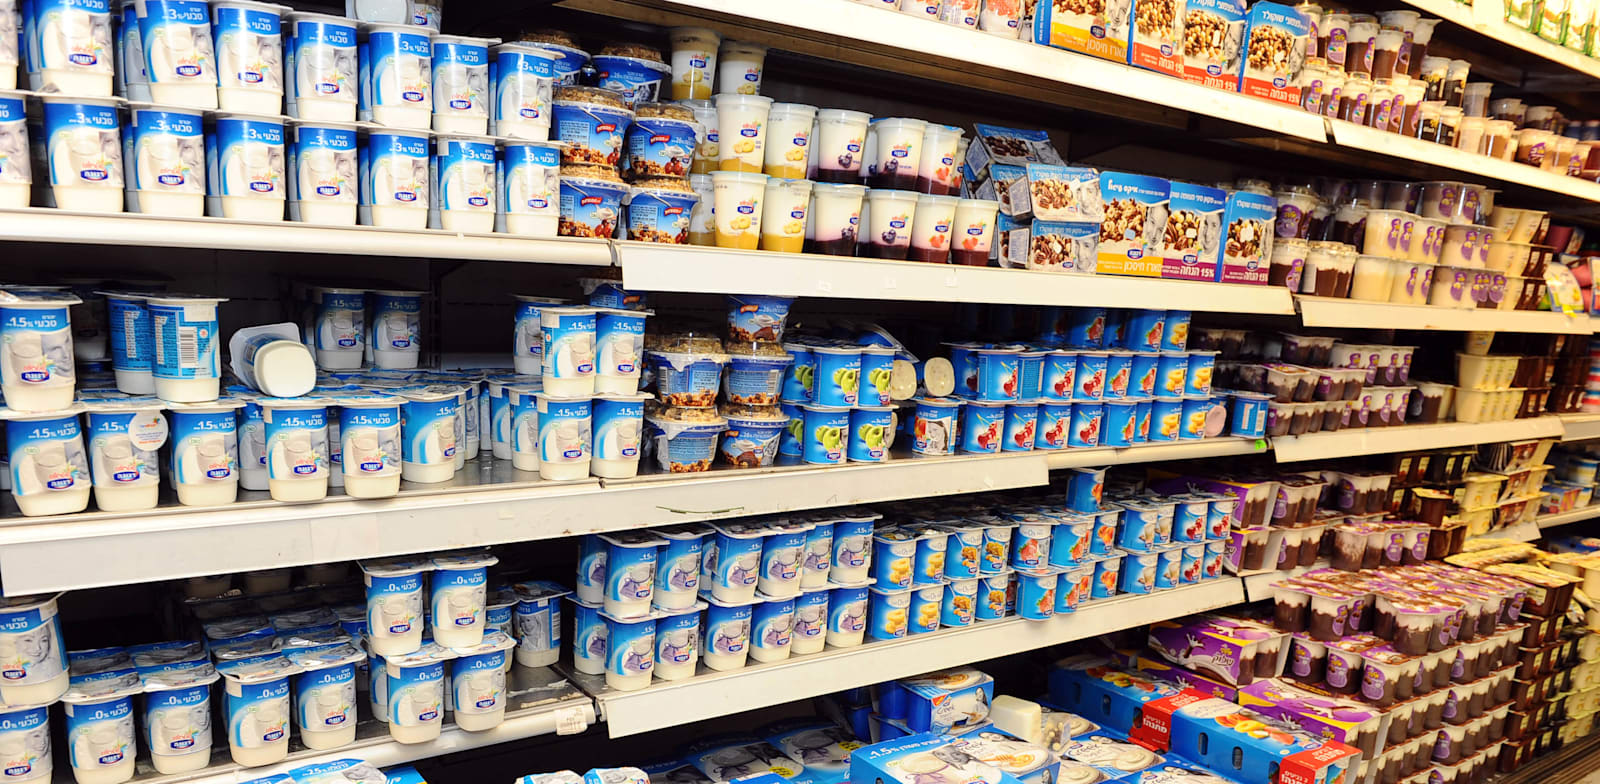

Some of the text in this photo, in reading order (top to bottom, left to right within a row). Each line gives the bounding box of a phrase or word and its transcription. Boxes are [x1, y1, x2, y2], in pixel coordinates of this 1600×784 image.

[1180, 265, 1199, 277] הנחה
[1201, 267, 1215, 278] 15%
[10, 317, 57, 328] טבעי 1.5%
[198, 420, 235, 431] טבעי 1.5%
[285, 417, 323, 427] טבעי 1.5%
[354, 416, 372, 425] 1.5%
[103, 421, 125, 431] 1.5%
[33, 427, 76, 439] טבעי 1.5%
[117, 472, 137, 480] דנונה
[50, 479, 71, 488] דנונה
[6, 621, 28, 630] טבעי
[4, 670, 24, 679] דנונה
[18, 717, 39, 727] טבעי
[1143, 718, 1167, 733] מתנה!
